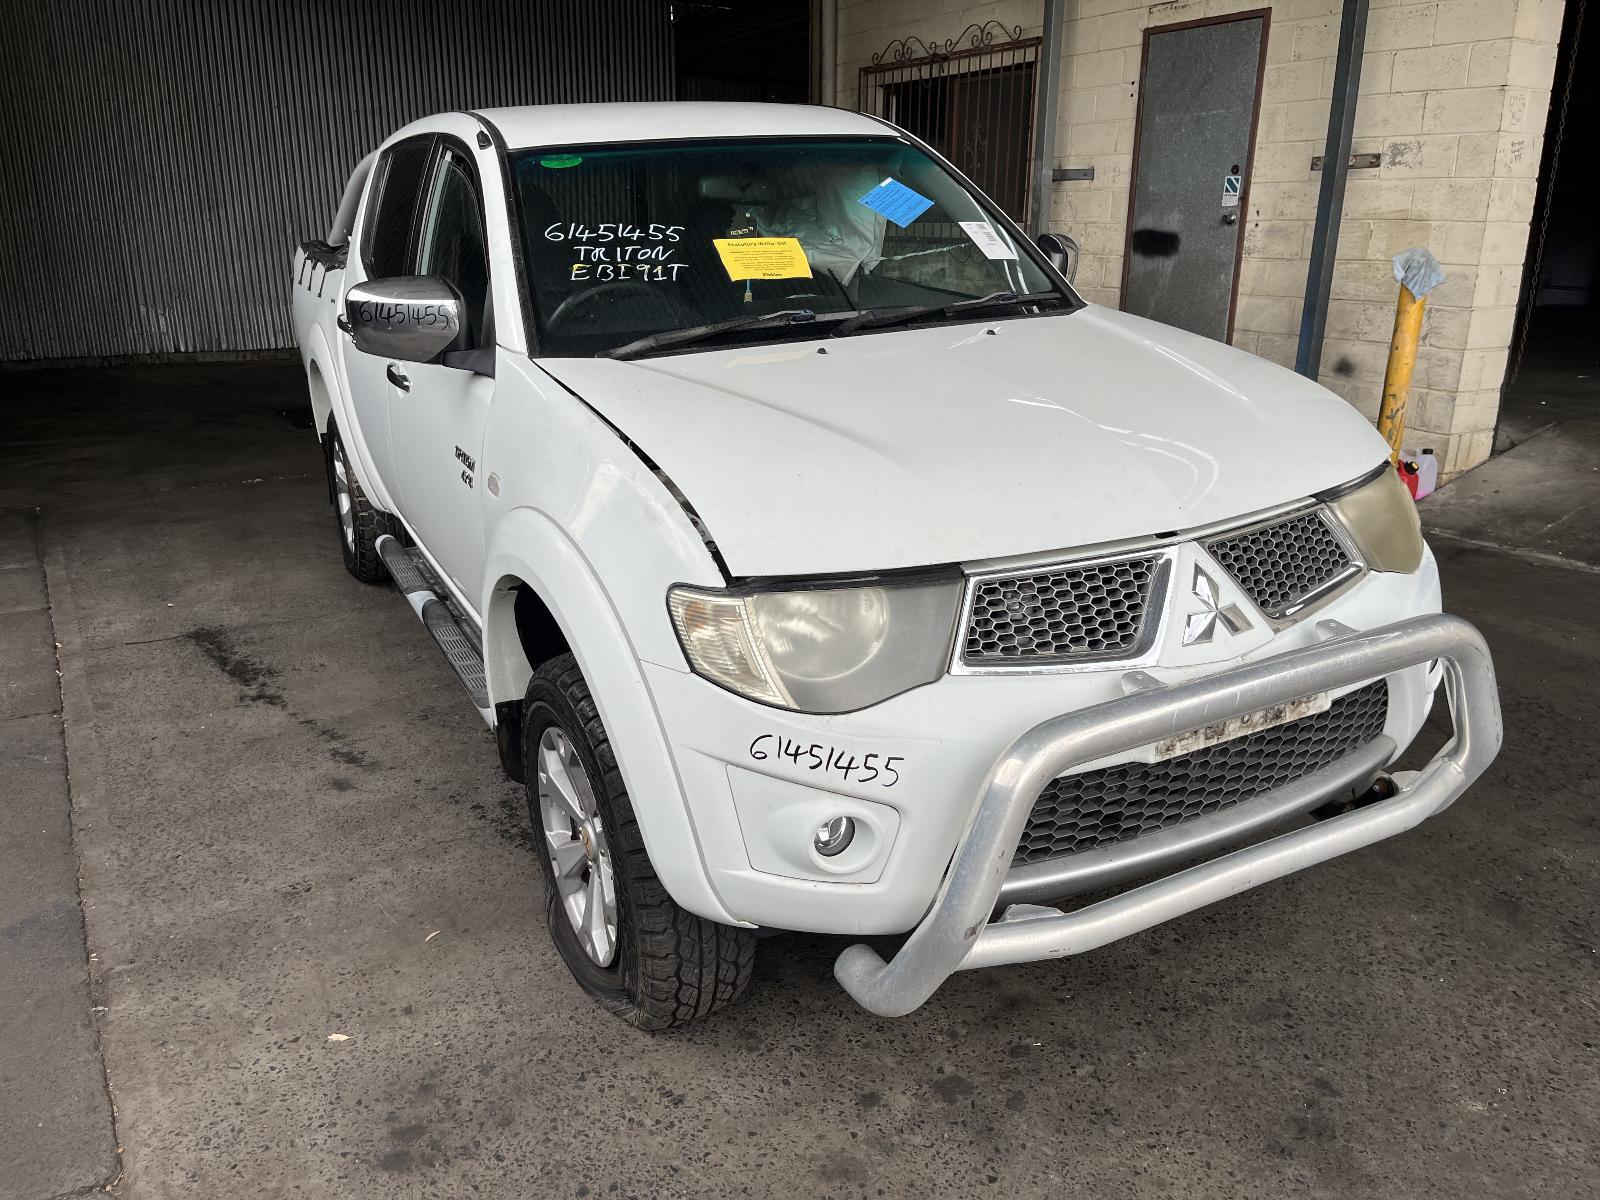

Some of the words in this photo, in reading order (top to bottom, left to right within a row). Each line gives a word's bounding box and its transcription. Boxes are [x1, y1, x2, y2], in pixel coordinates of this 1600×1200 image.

[544, 222, 686, 242] 61451455
[573, 245, 675, 262] TRITON
[358, 300, 449, 330] 61451455
[749, 733, 905, 788] 61451455
